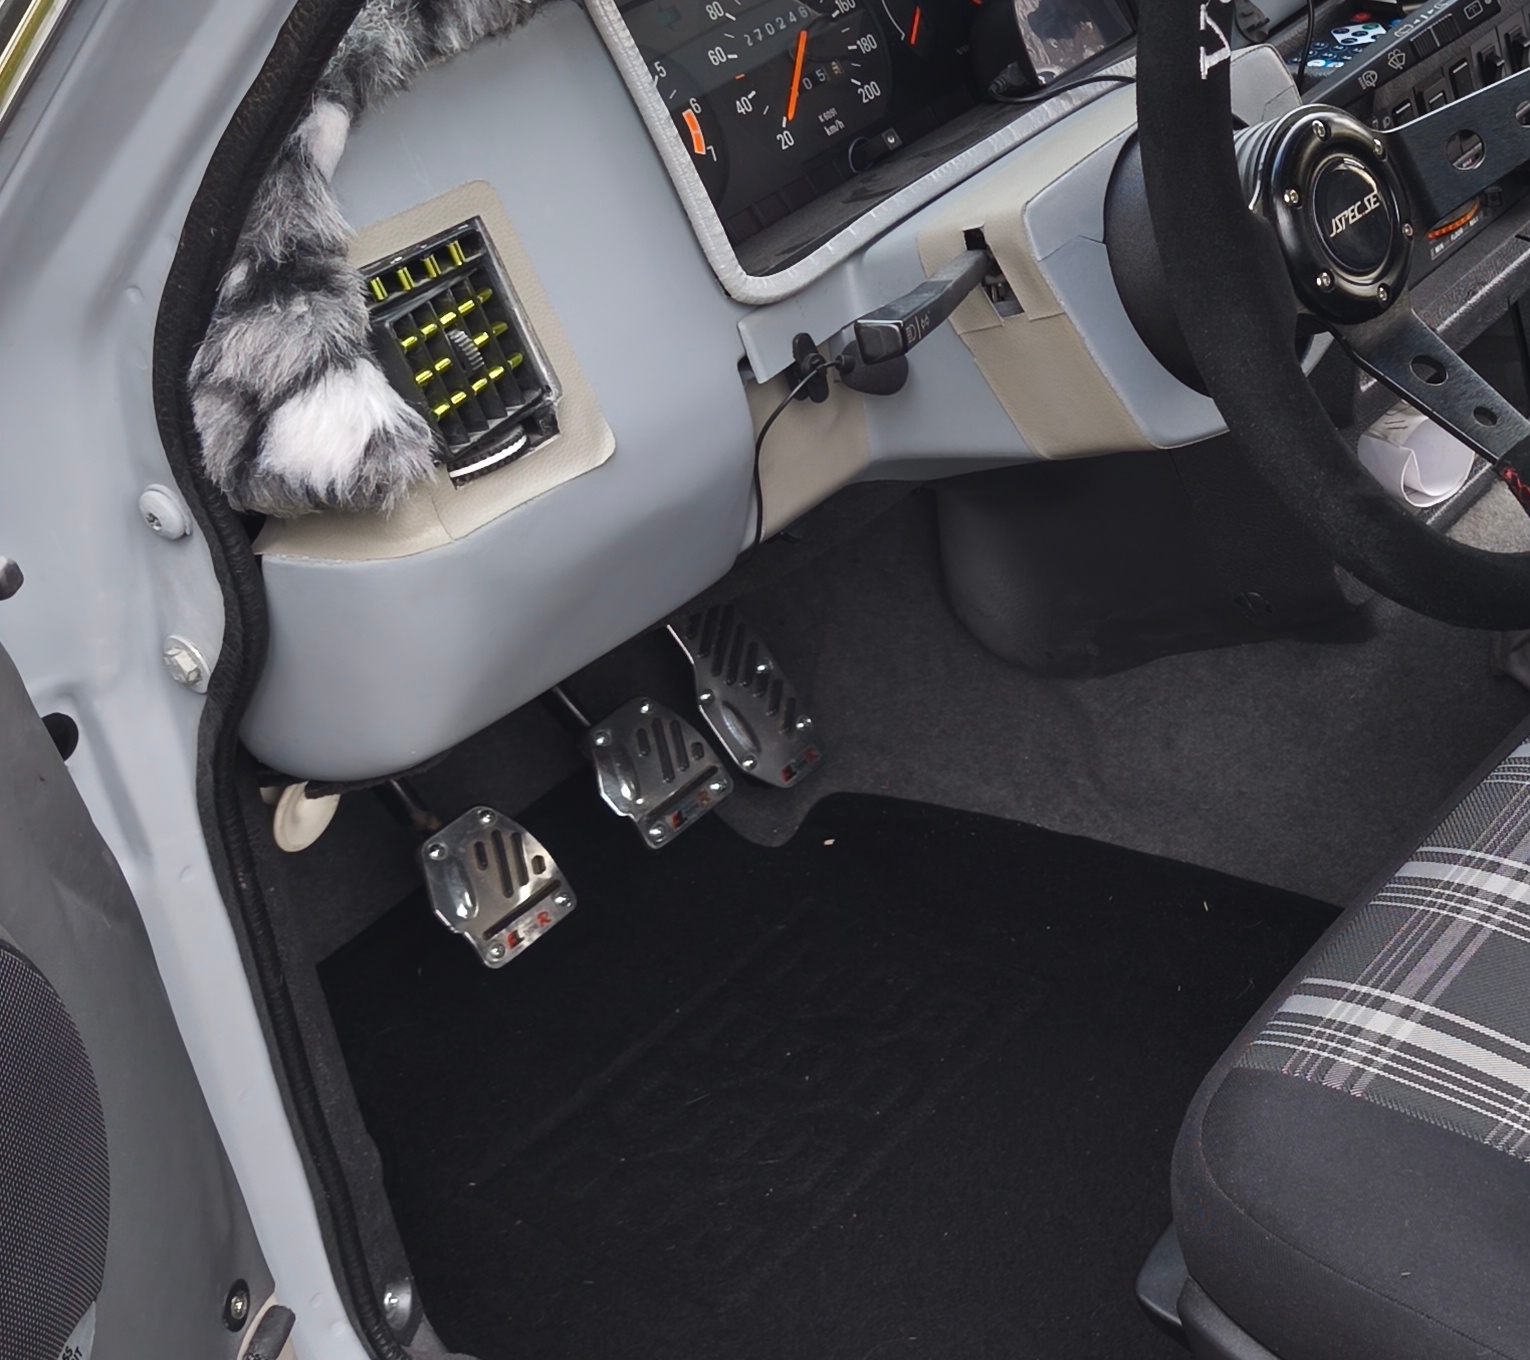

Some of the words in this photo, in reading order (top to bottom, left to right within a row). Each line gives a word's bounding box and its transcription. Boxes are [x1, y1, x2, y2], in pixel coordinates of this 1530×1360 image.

[705, 1, 725, 21] 80
[856, 33, 878, 55] 180
[707, 46, 727, 66] 60
[654, 61, 667, 78] 5
[857, 81, 882, 104] 200
[689, 97, 702, 114] 6
[735, 96, 753, 116] 40
[823, 119, 846, 137] km/h
[776, 130, 795, 151] 20
[706, 144, 717, 162] 7
